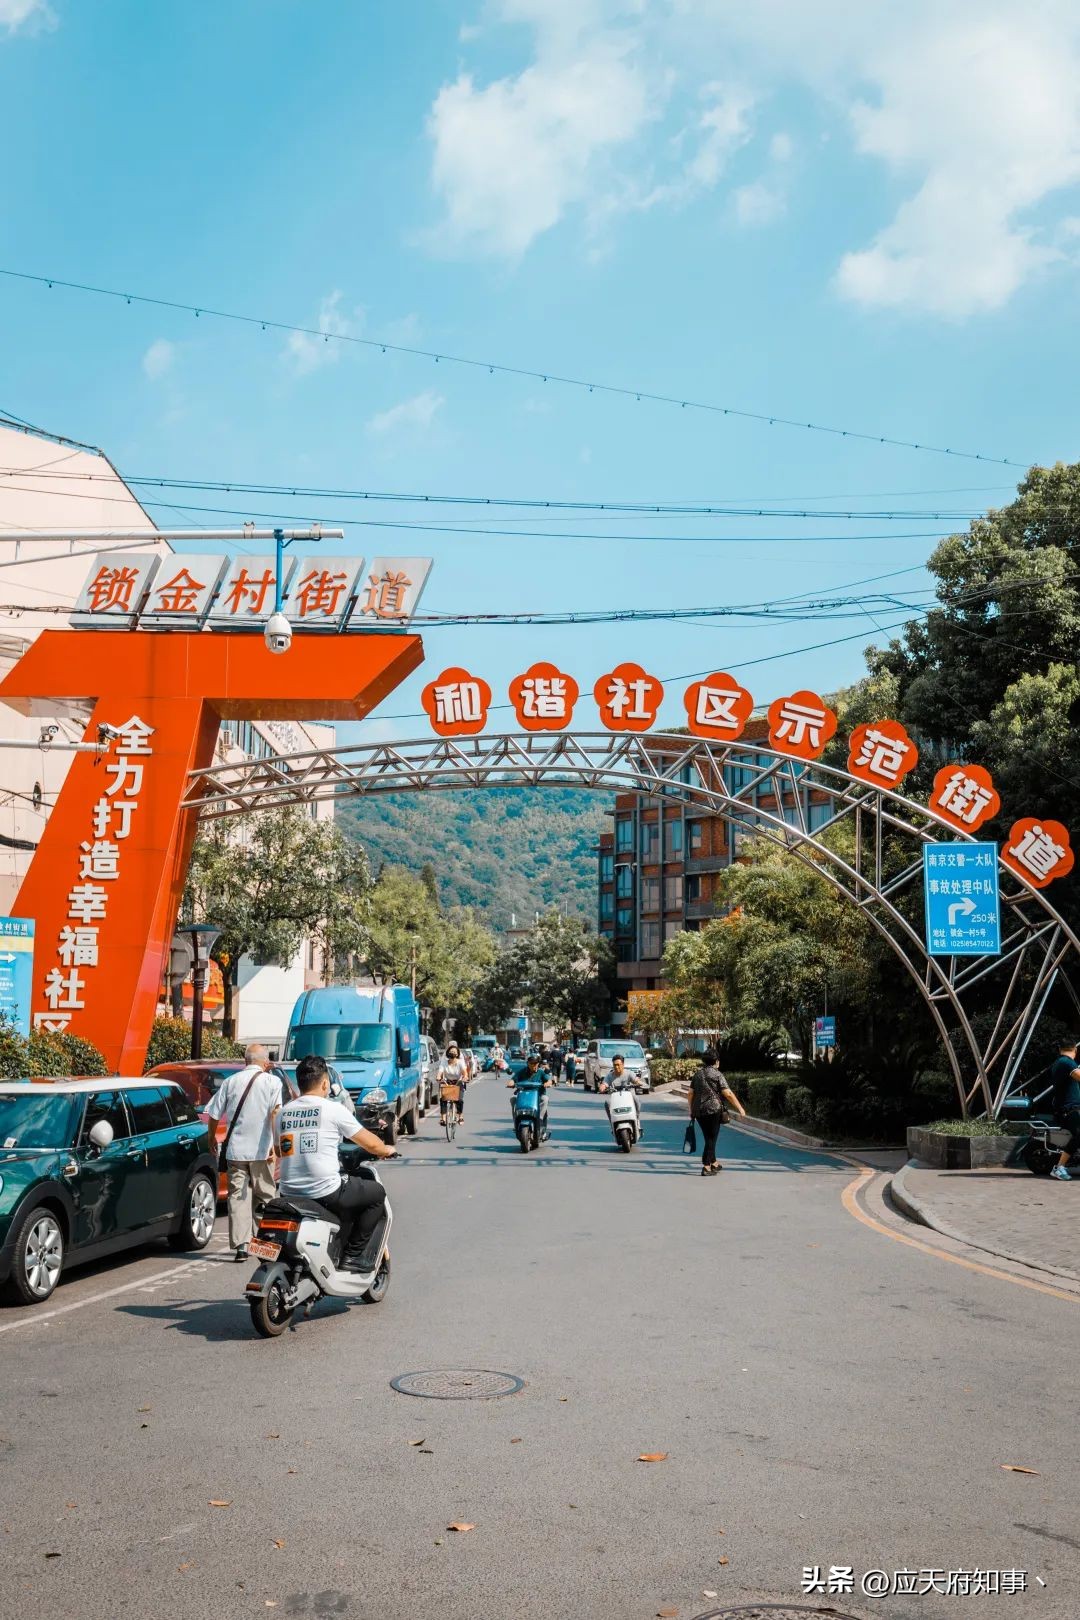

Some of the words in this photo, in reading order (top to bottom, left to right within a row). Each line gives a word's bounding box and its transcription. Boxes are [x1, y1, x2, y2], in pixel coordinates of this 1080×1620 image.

[88, 566, 412, 618] 锁金村街道
[434, 677, 1066, 881] 和谐社区示范街道
[928, 853, 994, 867] 南京交警一大队
[929, 879, 994, 895] 事故处理中队
[971, 912, 997, 925] 250米
